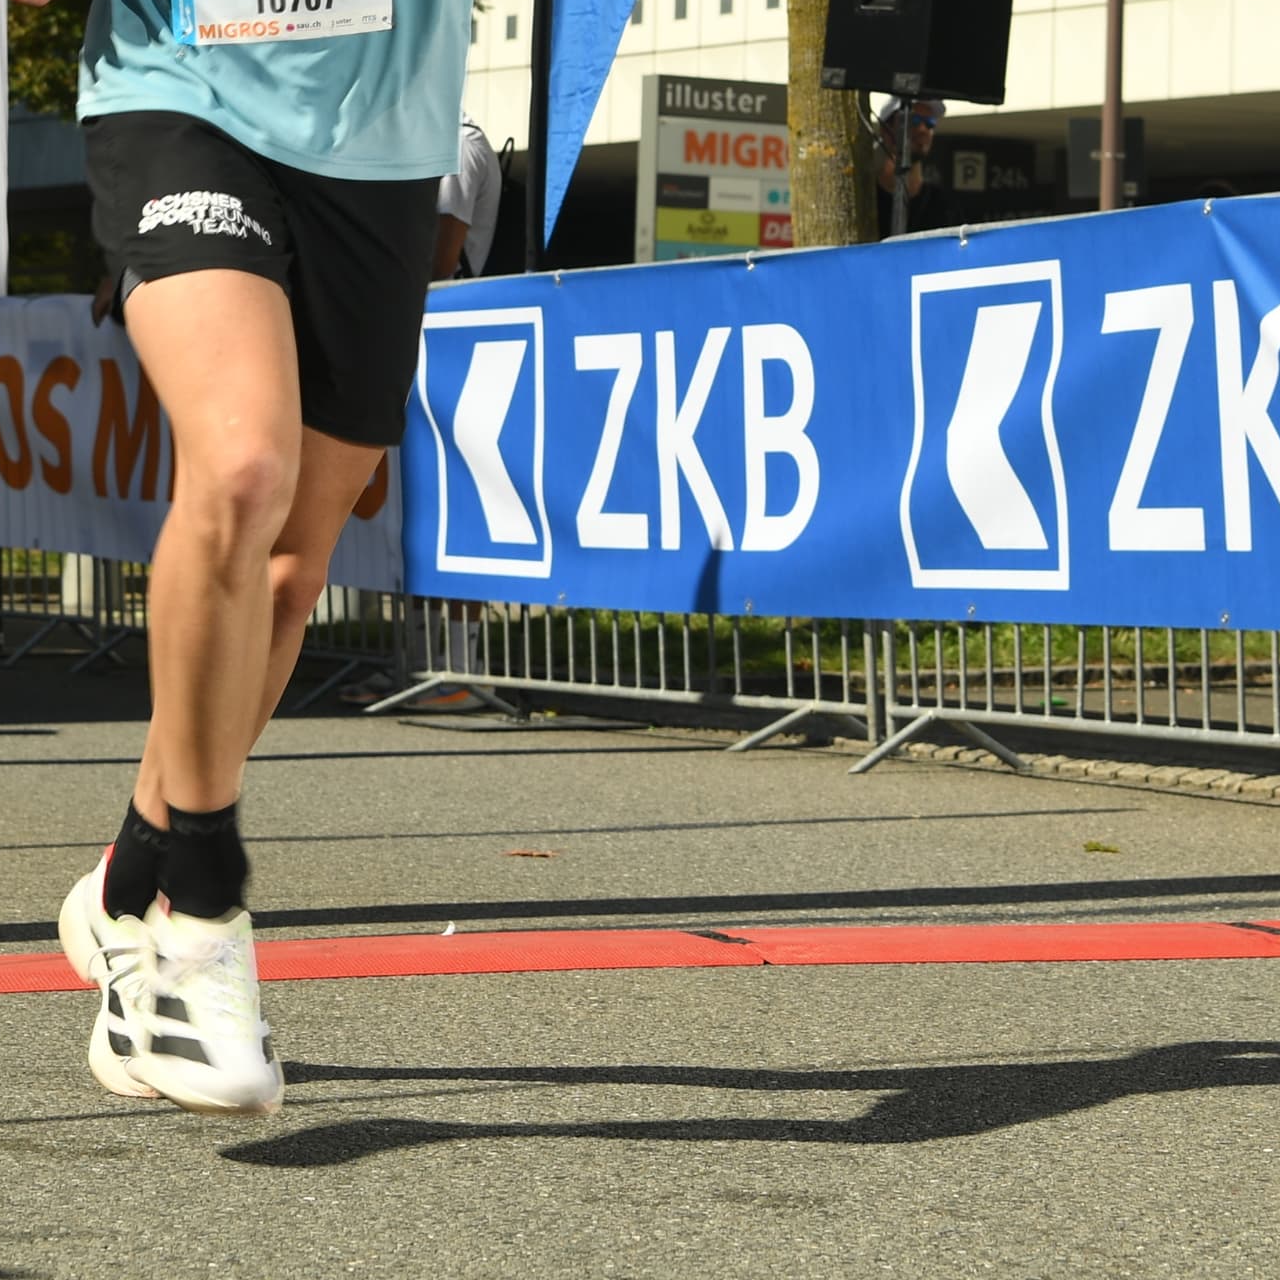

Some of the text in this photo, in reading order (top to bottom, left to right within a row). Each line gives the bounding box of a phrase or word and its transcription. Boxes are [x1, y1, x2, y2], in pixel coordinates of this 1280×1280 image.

[199, 21, 281, 39] MIGROS
[666, 84, 767, 114] illuster
[683, 130, 790, 170] MIGR
[188, 220, 247, 238] TEAM
[573, 322, 820, 552] ZKB
